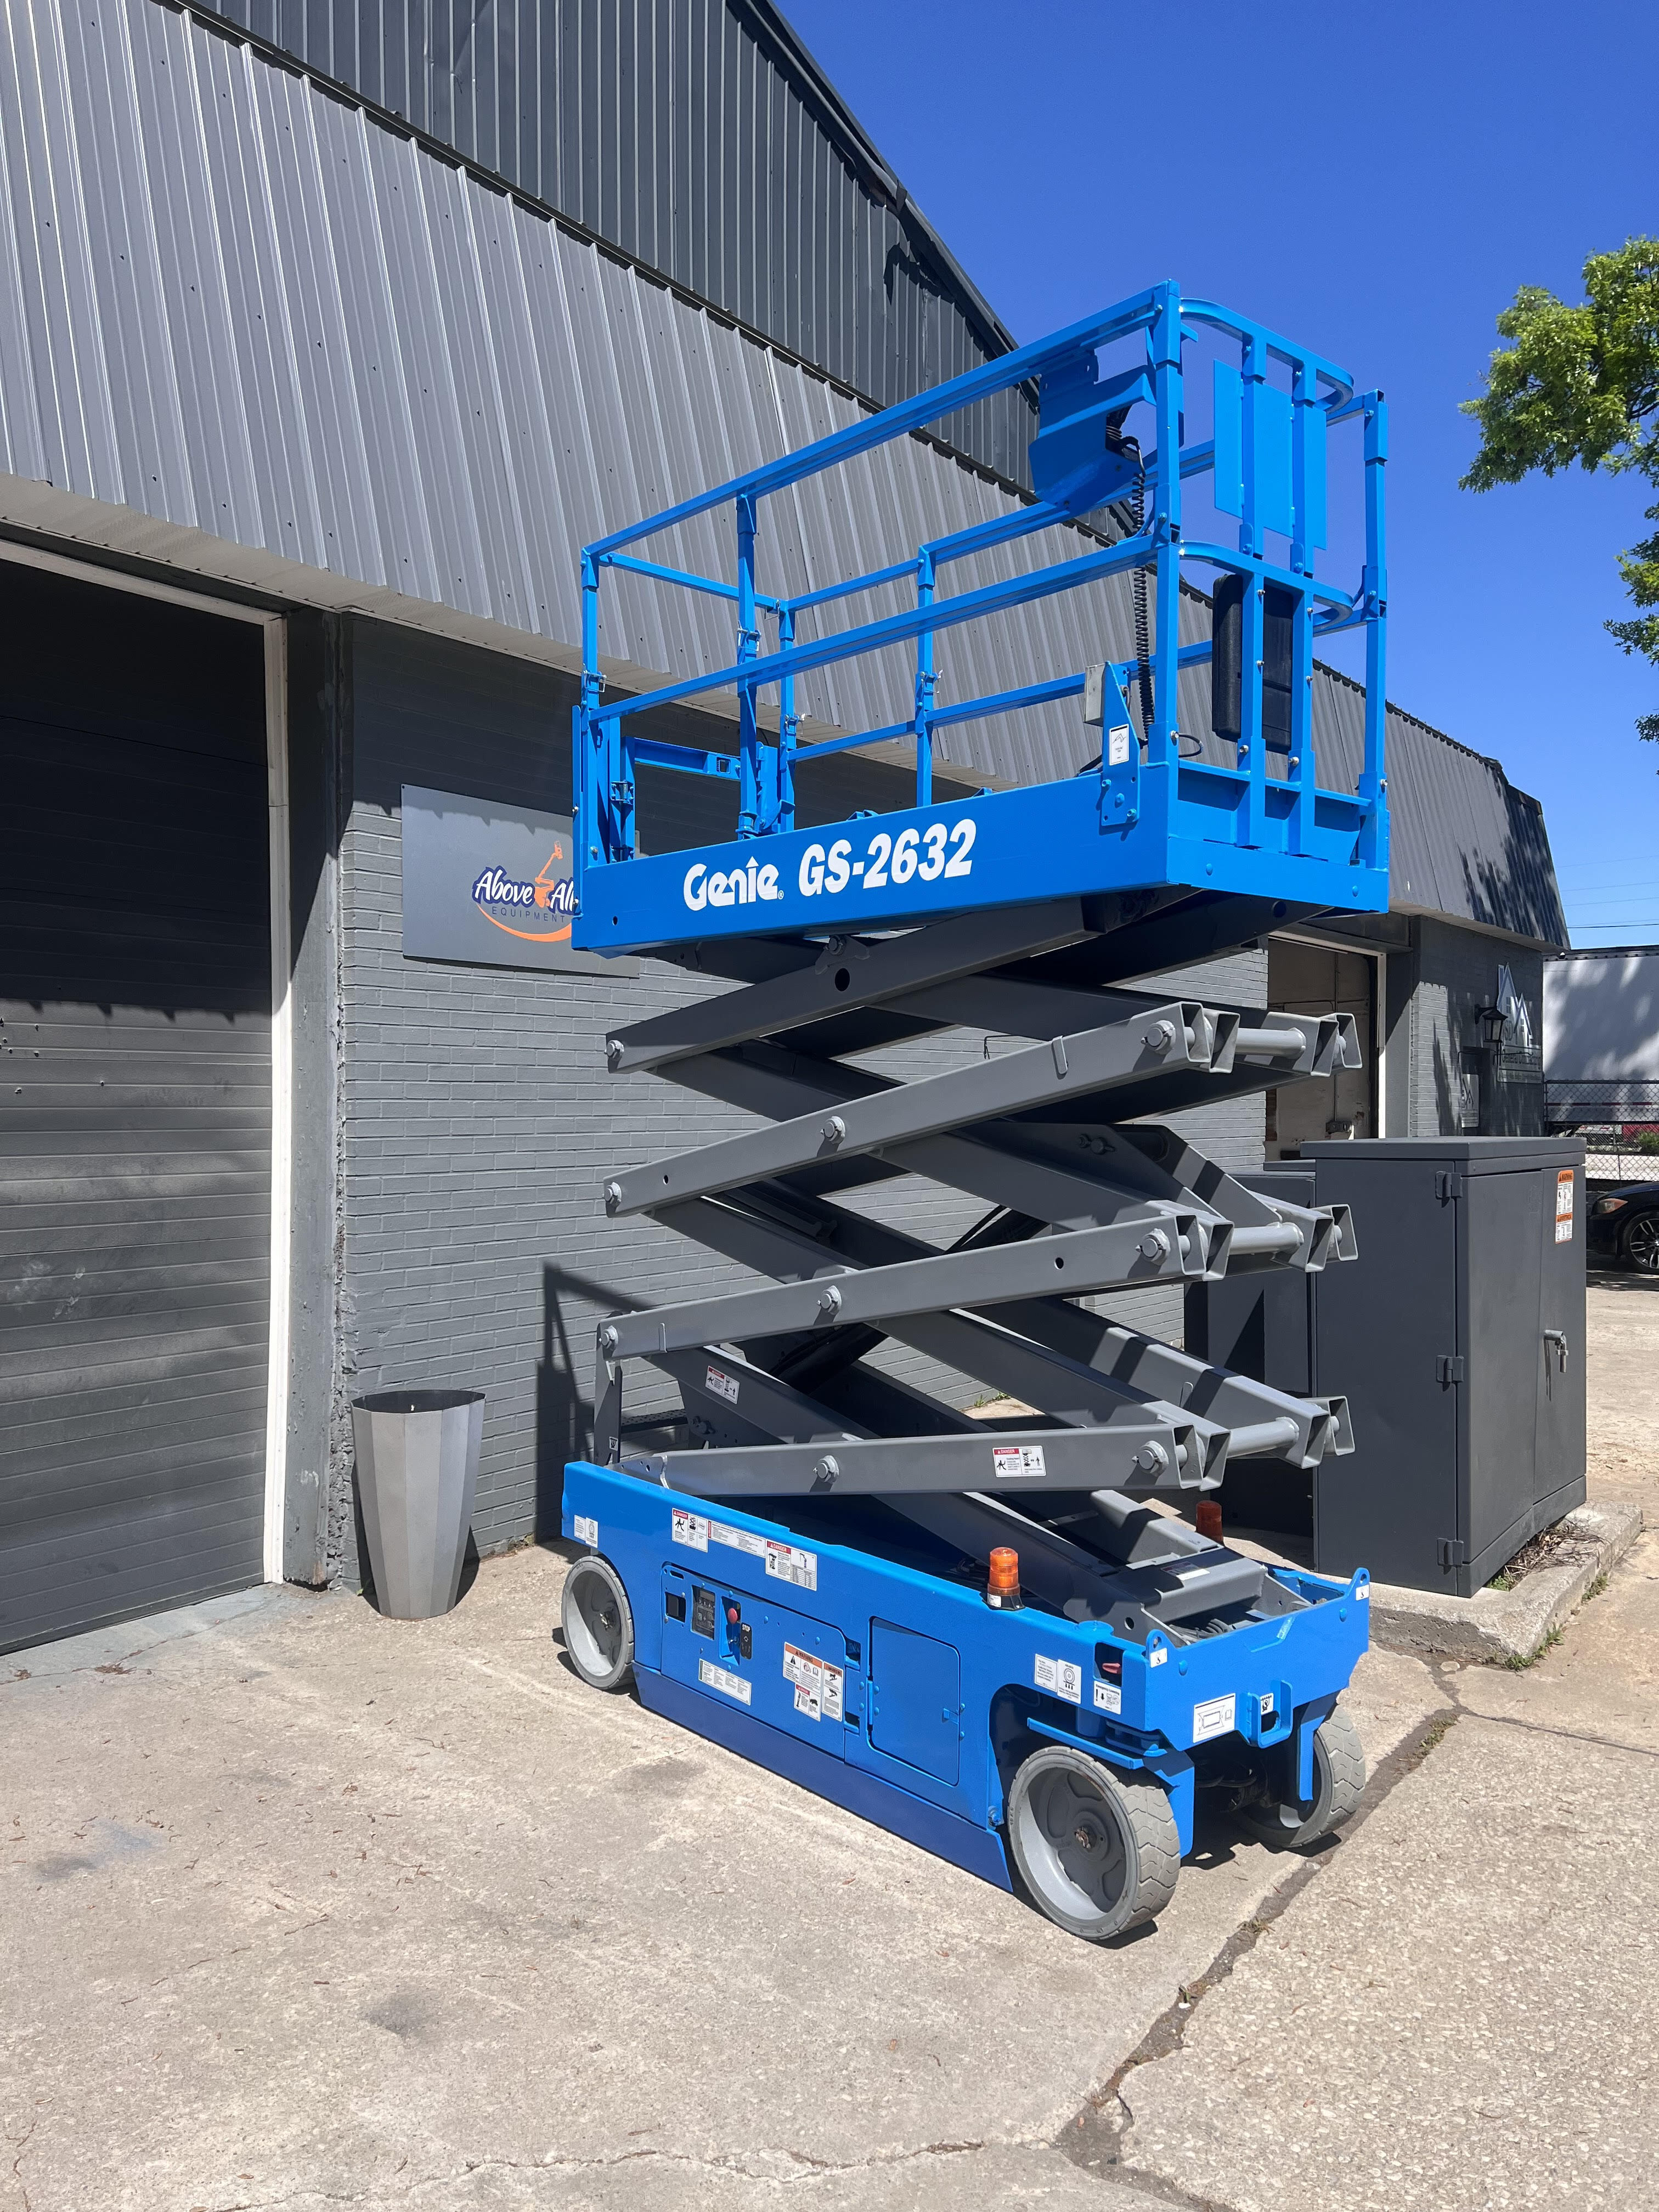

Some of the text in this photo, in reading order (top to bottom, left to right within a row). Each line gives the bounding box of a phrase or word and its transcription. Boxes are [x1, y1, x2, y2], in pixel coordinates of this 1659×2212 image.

[683, 819, 976, 911] Genie GS-2632
[475, 868, 533, 905] Above
[491, 906, 566, 923] EQUIPMENT
[772, 1543, 787, 1553] DANGER
[742, 1624, 751, 1632] STOP
